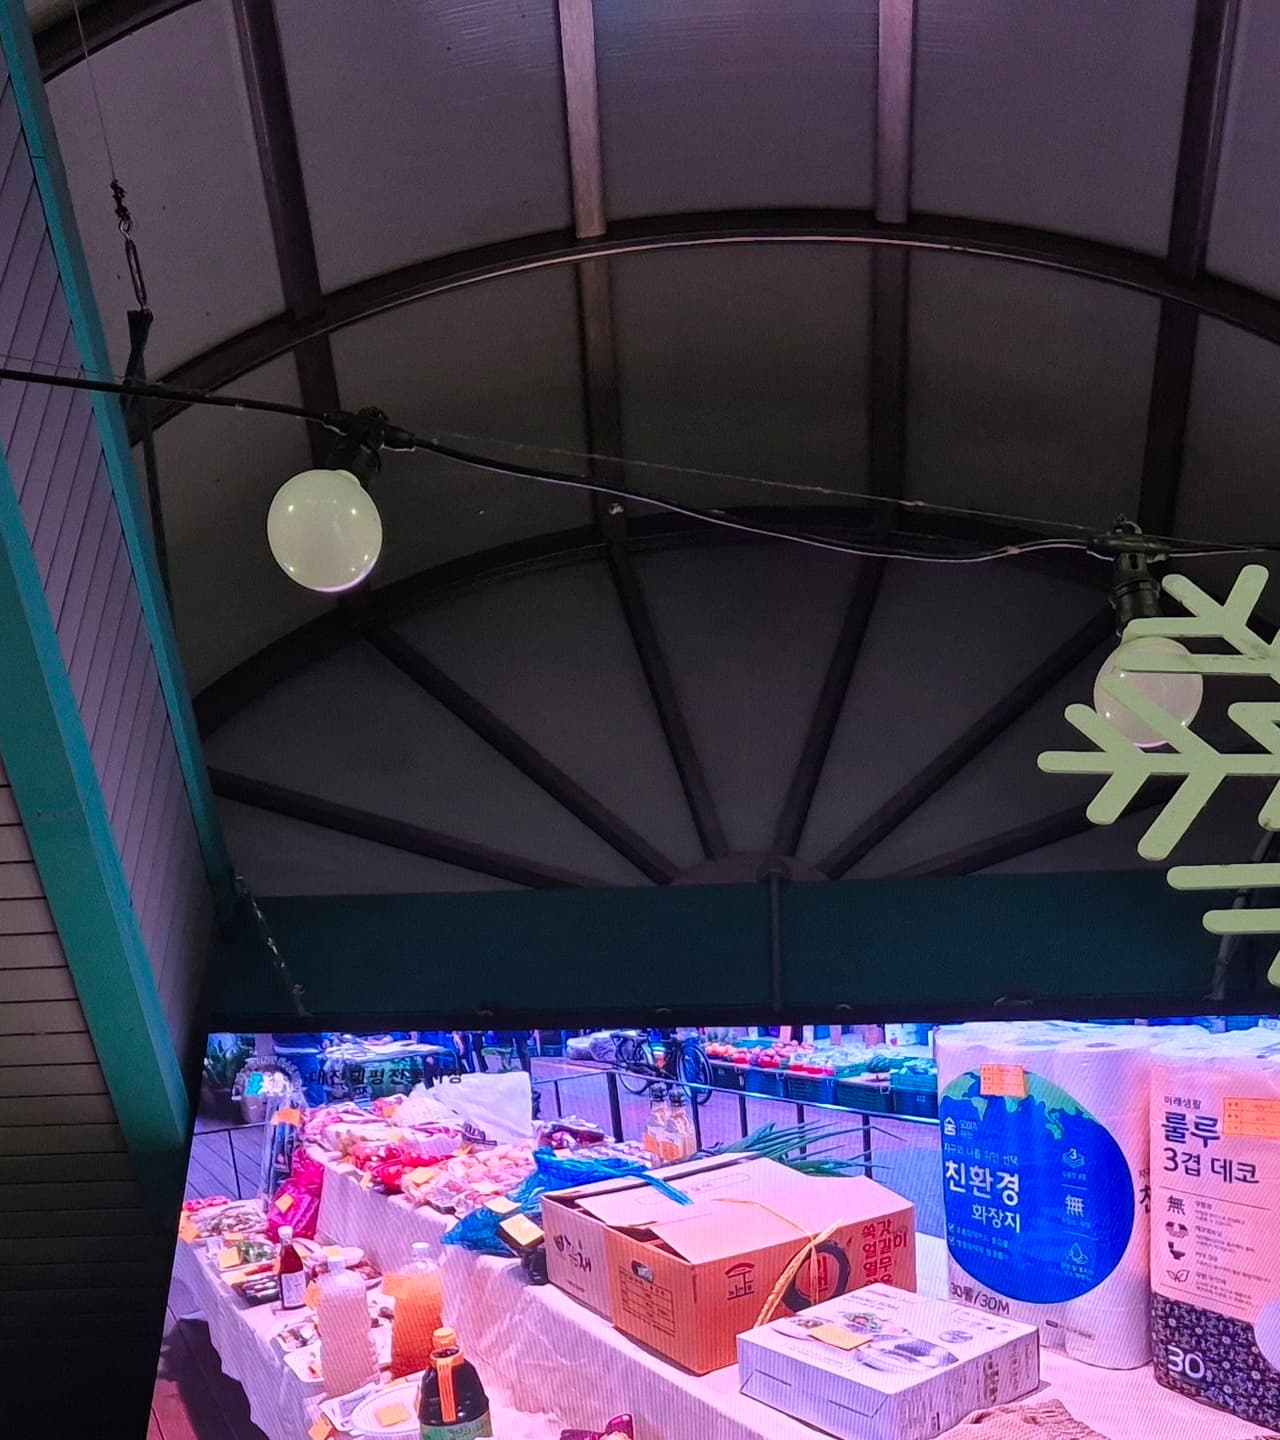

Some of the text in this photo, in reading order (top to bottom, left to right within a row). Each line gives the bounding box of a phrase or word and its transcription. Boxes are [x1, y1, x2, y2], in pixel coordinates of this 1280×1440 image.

[1161, 1110, 1221, 1148] 룰루
[945, 1159, 1020, 1207] 친환경
[1162, 1147, 1261, 1184] 3겹 데코
[971, 1203, 1021, 1234] 화장지
[1167, 1344, 1206, 1379] 30
